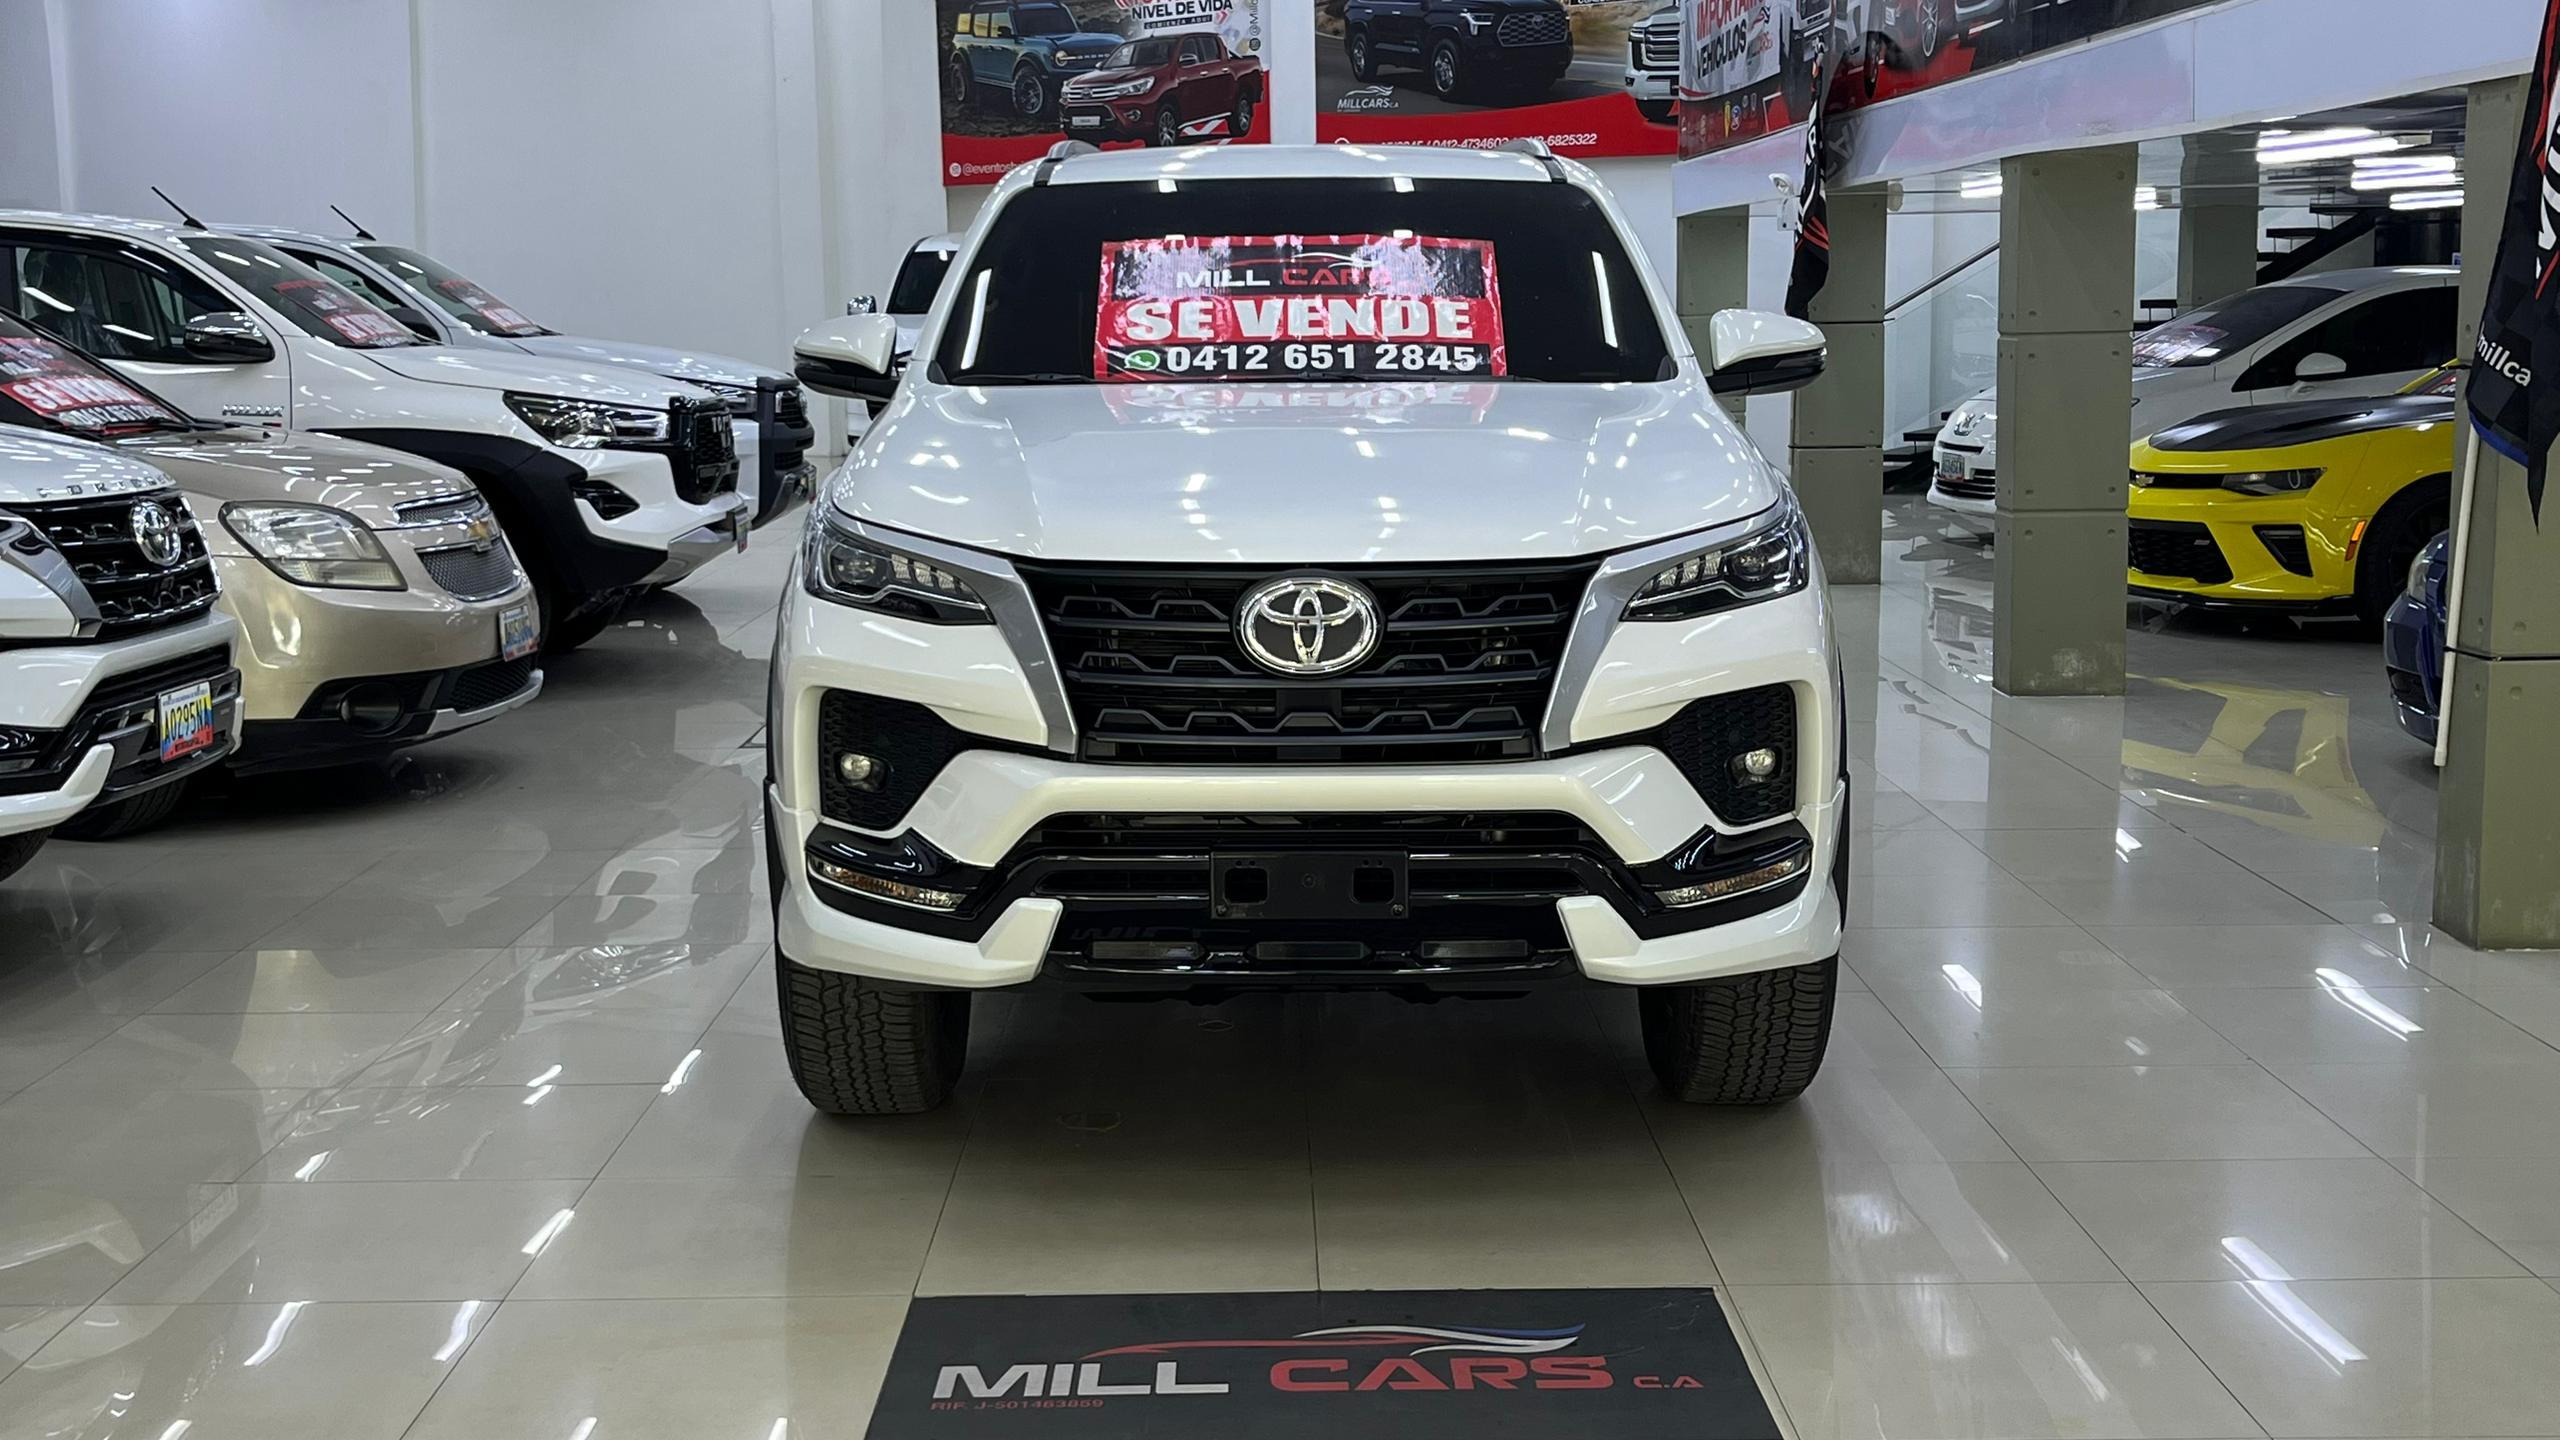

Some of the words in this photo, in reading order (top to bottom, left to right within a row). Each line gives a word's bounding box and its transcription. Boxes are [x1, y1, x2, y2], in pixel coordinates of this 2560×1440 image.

[1132, 5, 1173, 19] NIVEL
[1176, 2, 1197, 15] DE
[1199, 0, 1233, 13] VIDA
[1176, 268, 1271, 289] MILL
[1126, 300, 1217, 341] SE
[1231, 299, 1474, 340] VENDE
[1167, 344, 1268, 372] 0412
[1284, 344, 1356, 371] 651
[1376, 346, 1476, 371] 2845
[932, 1361, 1230, 1399] MILL
[1269, 1356, 1614, 1392] CARS
